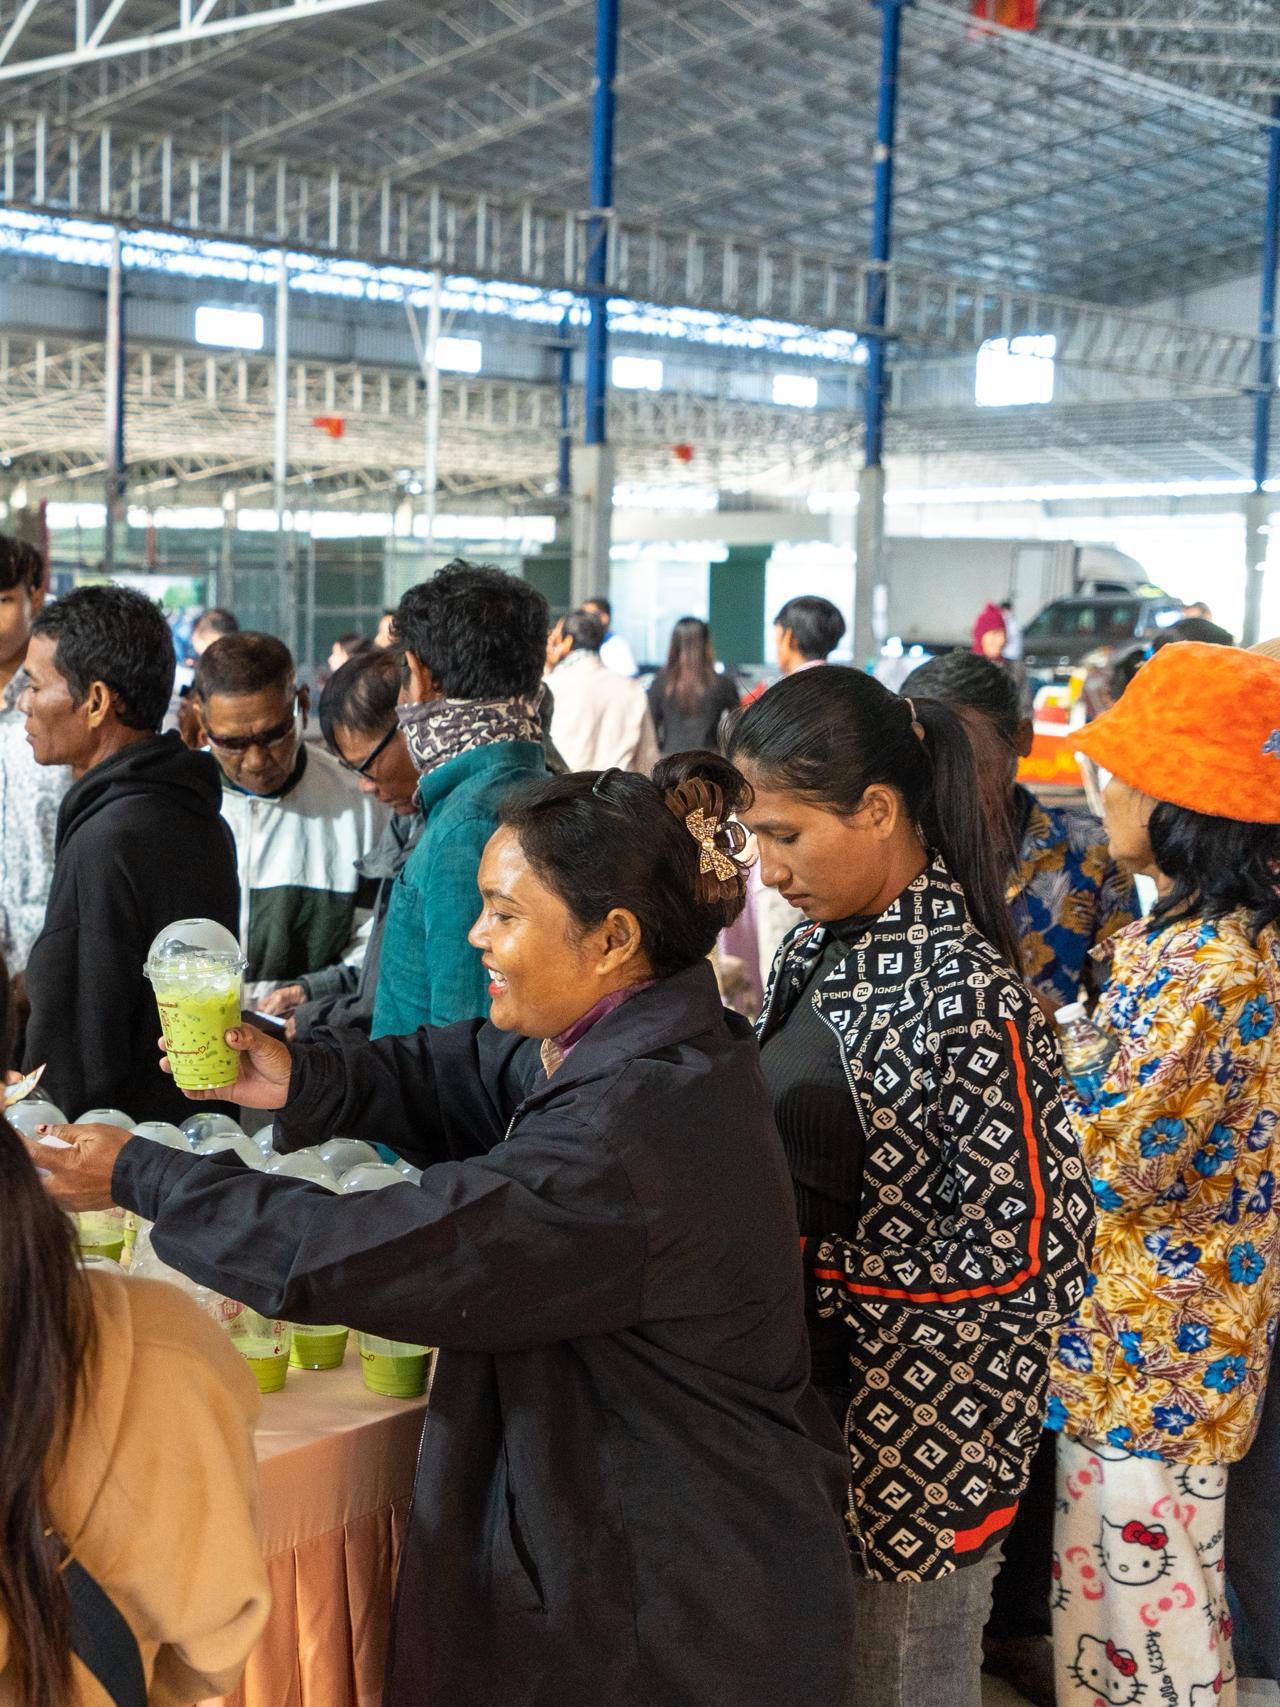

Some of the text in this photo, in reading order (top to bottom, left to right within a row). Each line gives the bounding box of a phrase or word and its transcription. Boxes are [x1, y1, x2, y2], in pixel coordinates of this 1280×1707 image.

[913, 893, 922, 922] FENDI
[874, 932, 906, 942] FENDI
[930, 925, 961, 936] FENDI
[858, 950, 866, 980] FENDI
[914, 945, 922, 972] FENDI
[822, 991, 852, 1000] FENDI
[874, 984, 905, 994] FENDI
[975, 989, 985, 1017] FENDI
[855, 1031, 873, 1060] FENDI
[940, 1026, 968, 1040] FENDI
[956, 1076, 983, 1095] FENDI
[891, 1086, 914, 1112] FENDI
[893, 1125, 920, 1151] FENDI
[964, 1146, 993, 1168] FENDI
[897, 1164, 921, 1188] FENDI
[861, 1203, 884, 1225] FENDI
[900, 1201, 930, 1223] FENDI
[886, 1385, 917, 1409] FENDI
[931, 1380, 956, 1407] FENDI
[972, 1379, 1003, 1399] FENDI
[894, 1423, 919, 1450] FENDI
[935, 1420, 965, 1446] FENDI
[859, 1464, 884, 1490] FENDI
[899, 1464, 927, 1488] FENDI
[940, 1459, 966, 1487] FENDI
[872, 1549, 901, 1574] FENDI
[917, 1549, 942, 1575] FENDI
